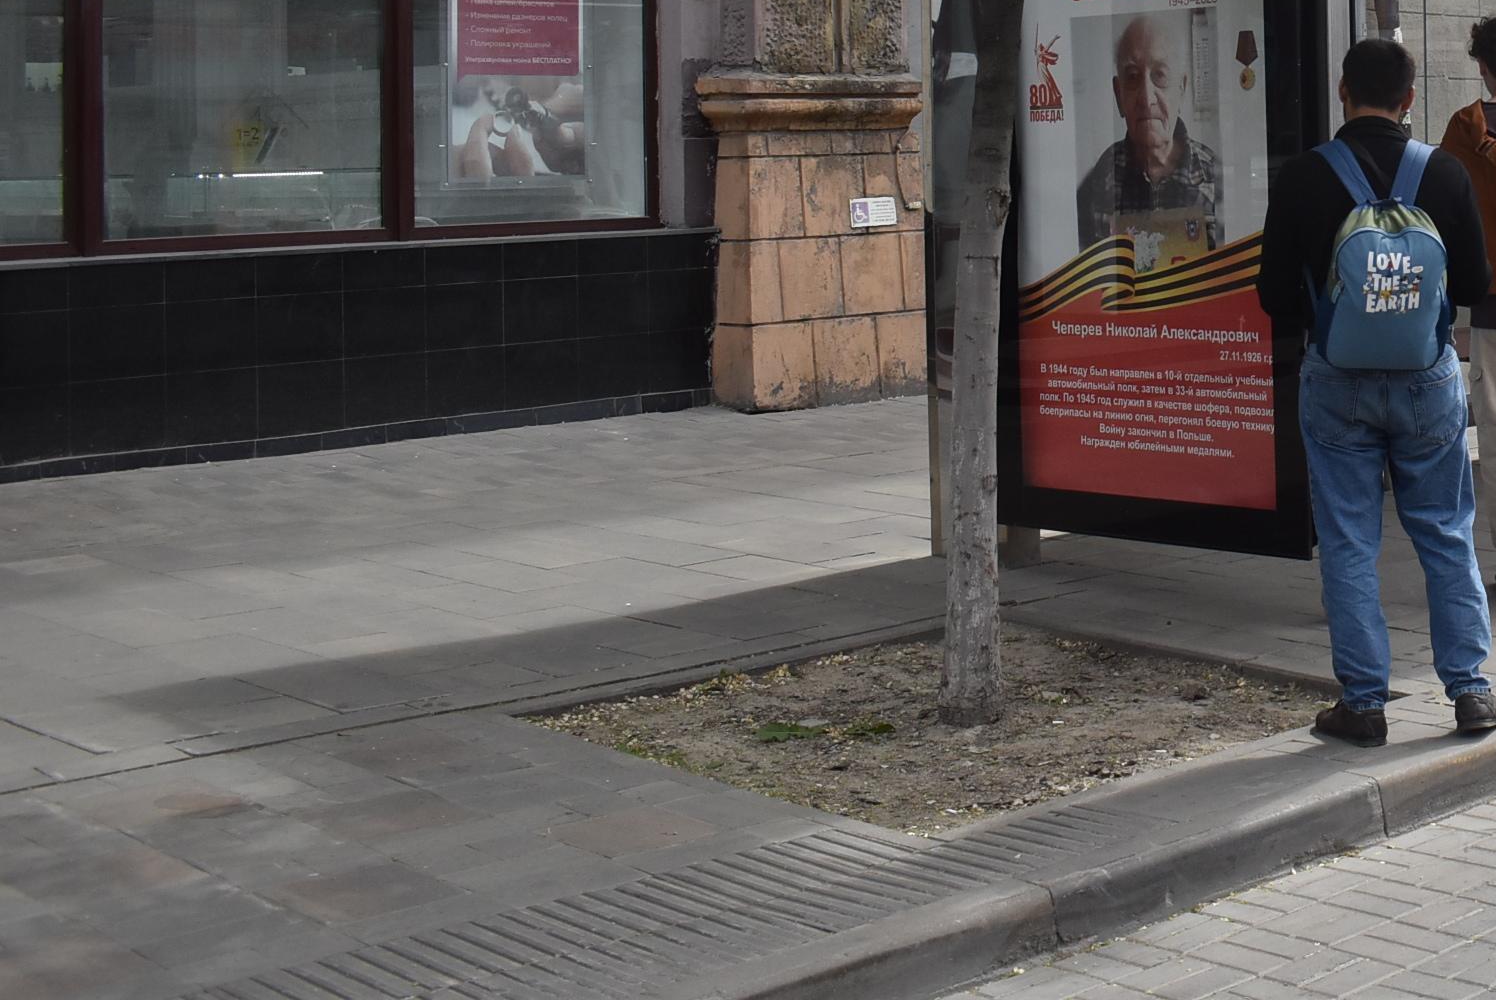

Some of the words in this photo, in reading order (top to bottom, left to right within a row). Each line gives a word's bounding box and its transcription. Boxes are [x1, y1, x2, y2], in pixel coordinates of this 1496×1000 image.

[1030, 110, 1064, 123] ПОБЕДА!
[1367, 251, 1411, 274] LOVE
[1371, 273, 1400, 291] THE
[1366, 291, 1420, 313] EARTH
[1052, 320, 1102, 338] Чеперев
[1106, 322, 1157, 338] Николай
[1161, 325, 1259, 344] Александрович
[1219, 350, 1261, 362] 27.11.1926
[1041, 363, 1047, 373] В
[1049, 364, 1067, 373] 1944
[1069, 366, 1087, 377] году
[1090, 365, 1107, 376] был
[1110, 368, 1154, 380] направлен
[1165, 370, 1182, 380] 10-й
[1184, 373, 1233, 384] отдельный
[1235, 375, 1274, 387] учебный
[1048, 378, 1115, 391] автомобильный
[1117, 383, 1140, 394] полк,
[1141, 385, 1165, 395] затем
[1175, 385, 1194, 395] 33-й
[1195, 388, 1267, 401] автомобильный
[1040, 393, 1060, 402] полк.
[1063, 392, 1074, 402] По
[1077, 393, 1095, 404] 1945
[1097, 396, 1112, 406] год
[1113, 398, 1145, 408] служил
[1154, 400, 1192, 411] качестве
[1194, 402, 1232, 414] шофера,
[1040, 404, 1091, 418] боеприпасы
[1093, 411, 1103, 419] на
[1105, 411, 1133, 421] линию
[1135, 413, 1156, 424] огня,
[1158, 415, 1204, 427] перегонял
[1206, 416, 1239, 431] боевую
[1099, 423, 1126, 437] Войну
[1127, 426, 1167, 438] закончил
[1176, 429, 1214, 442] Польше.
[1080, 435, 1126, 448] Награжден
[1127, 439, 1185, 453] юбилейными
[1187, 445, 1235, 458] медалями.
